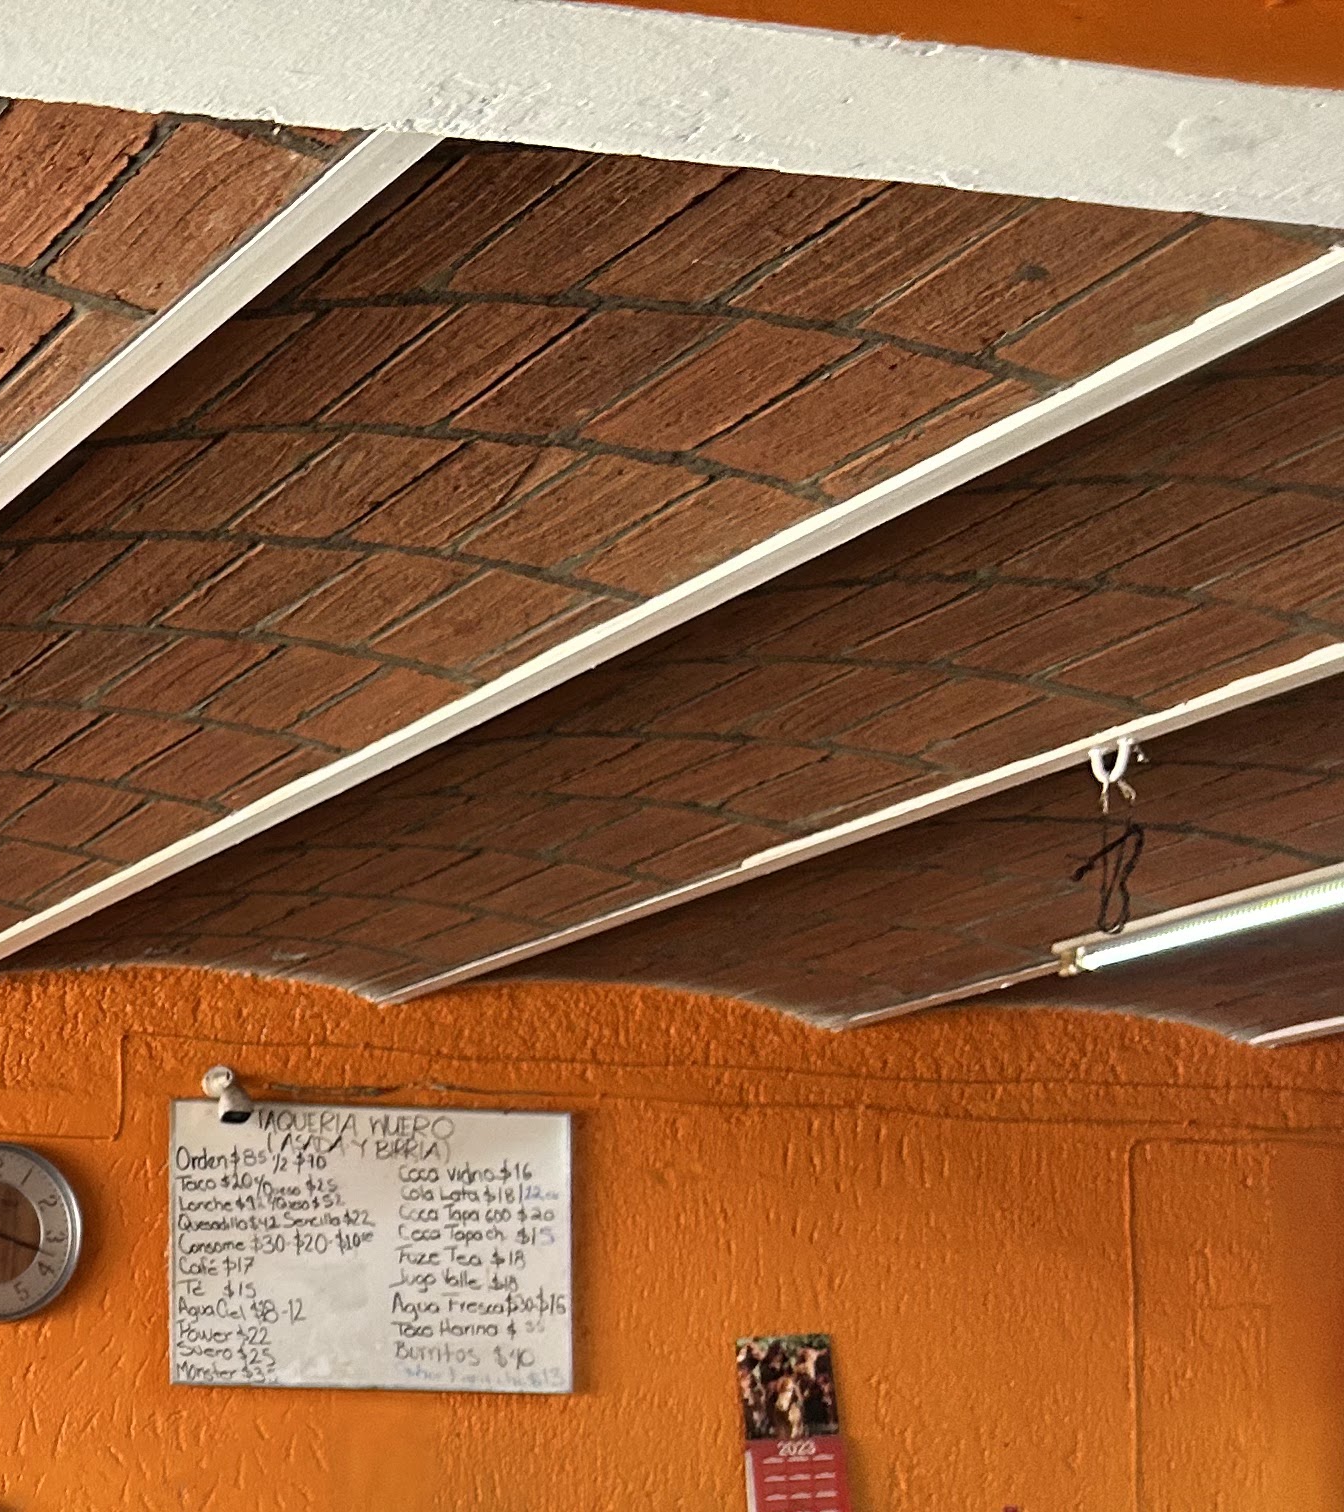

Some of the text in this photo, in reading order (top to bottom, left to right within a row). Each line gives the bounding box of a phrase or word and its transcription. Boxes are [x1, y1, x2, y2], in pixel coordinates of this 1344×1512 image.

[175, 1145, 228, 1172] Orden
[21, 1167, 33, 1185] 1
[398, 1163, 440, 1184] Coca
[496, 1157, 533, 1185] $16
[175, 1174, 217, 1192] Taco
[38, 1195, 61, 1212] 2
[398, 1203, 439, 1222] Coca
[46, 1230, 67, 1244] 3
[398, 1223, 441, 1242] Coca
[443, 1244, 483, 1266] Tea
[37, 1261, 55, 1277] 4
[178, 1255, 256, 1278] Café $17
[14, 1282, 30, 1302] 5
[176, 1279, 257, 1300] Té $15
[391, 1291, 441, 1322] Agua
[394, 1340, 482, 1368] Burritos
